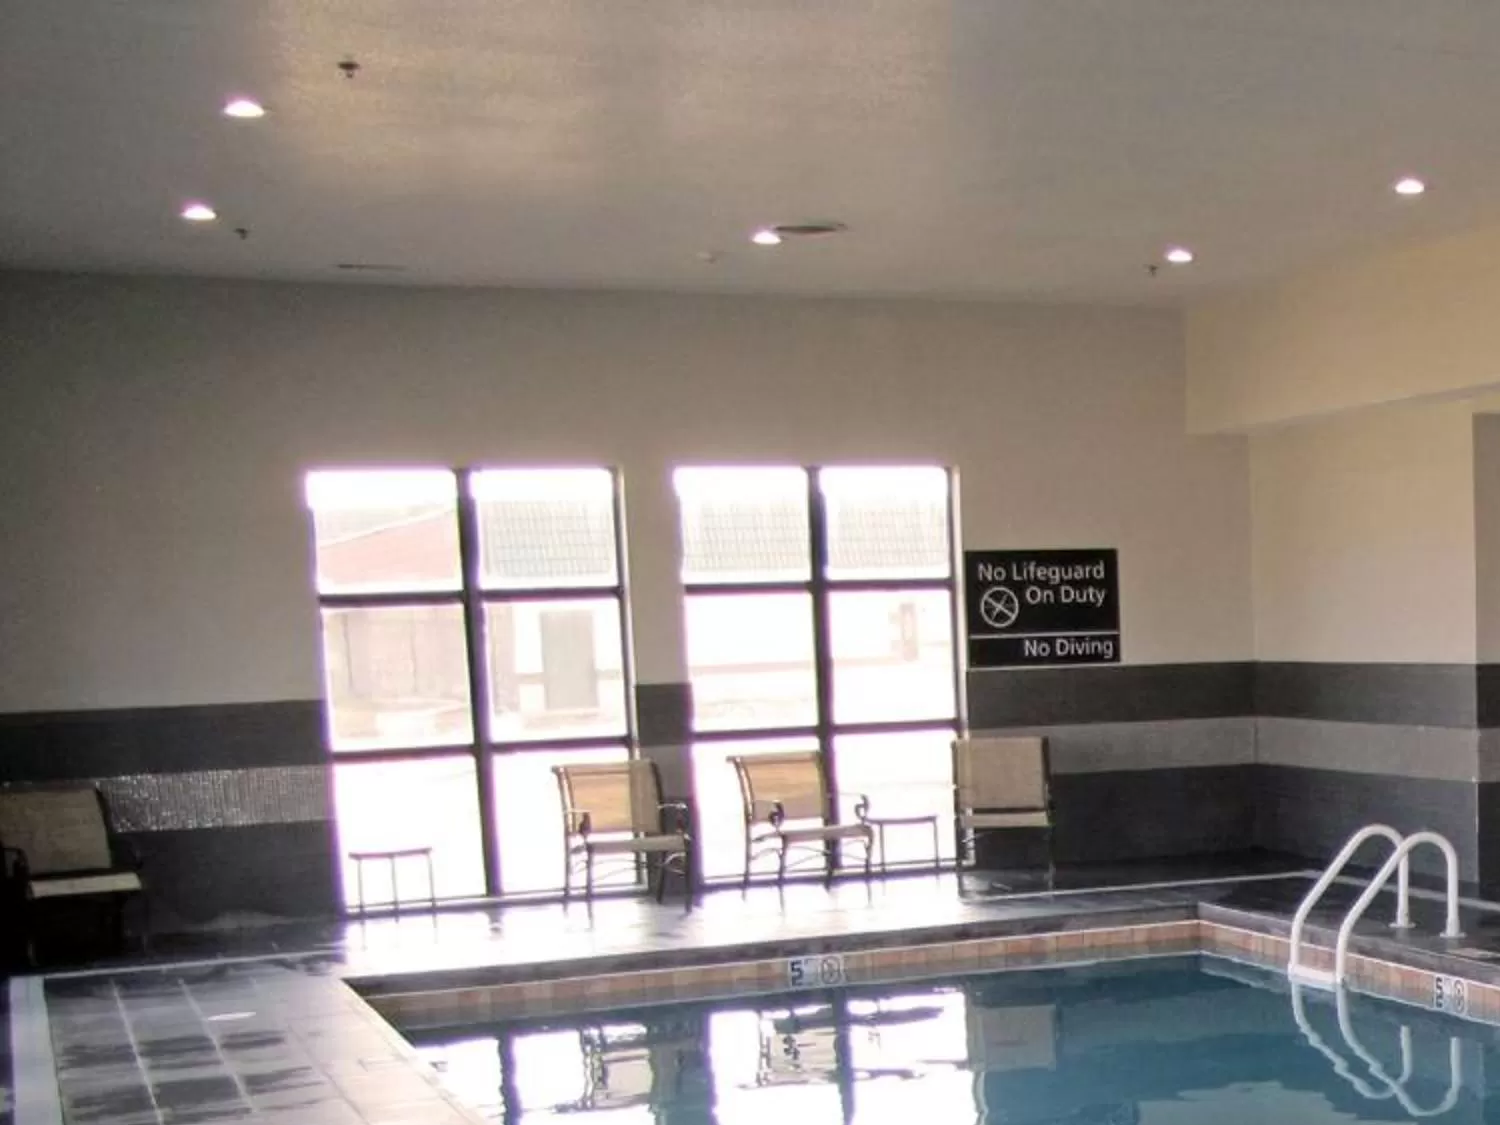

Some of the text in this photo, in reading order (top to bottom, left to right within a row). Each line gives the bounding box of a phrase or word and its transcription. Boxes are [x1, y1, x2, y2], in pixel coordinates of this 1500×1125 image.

[977, 560, 1105, 585] No Lifeguard
[1025, 585, 1106, 607] On Duty
[1023, 637, 1114, 659] No Diving
